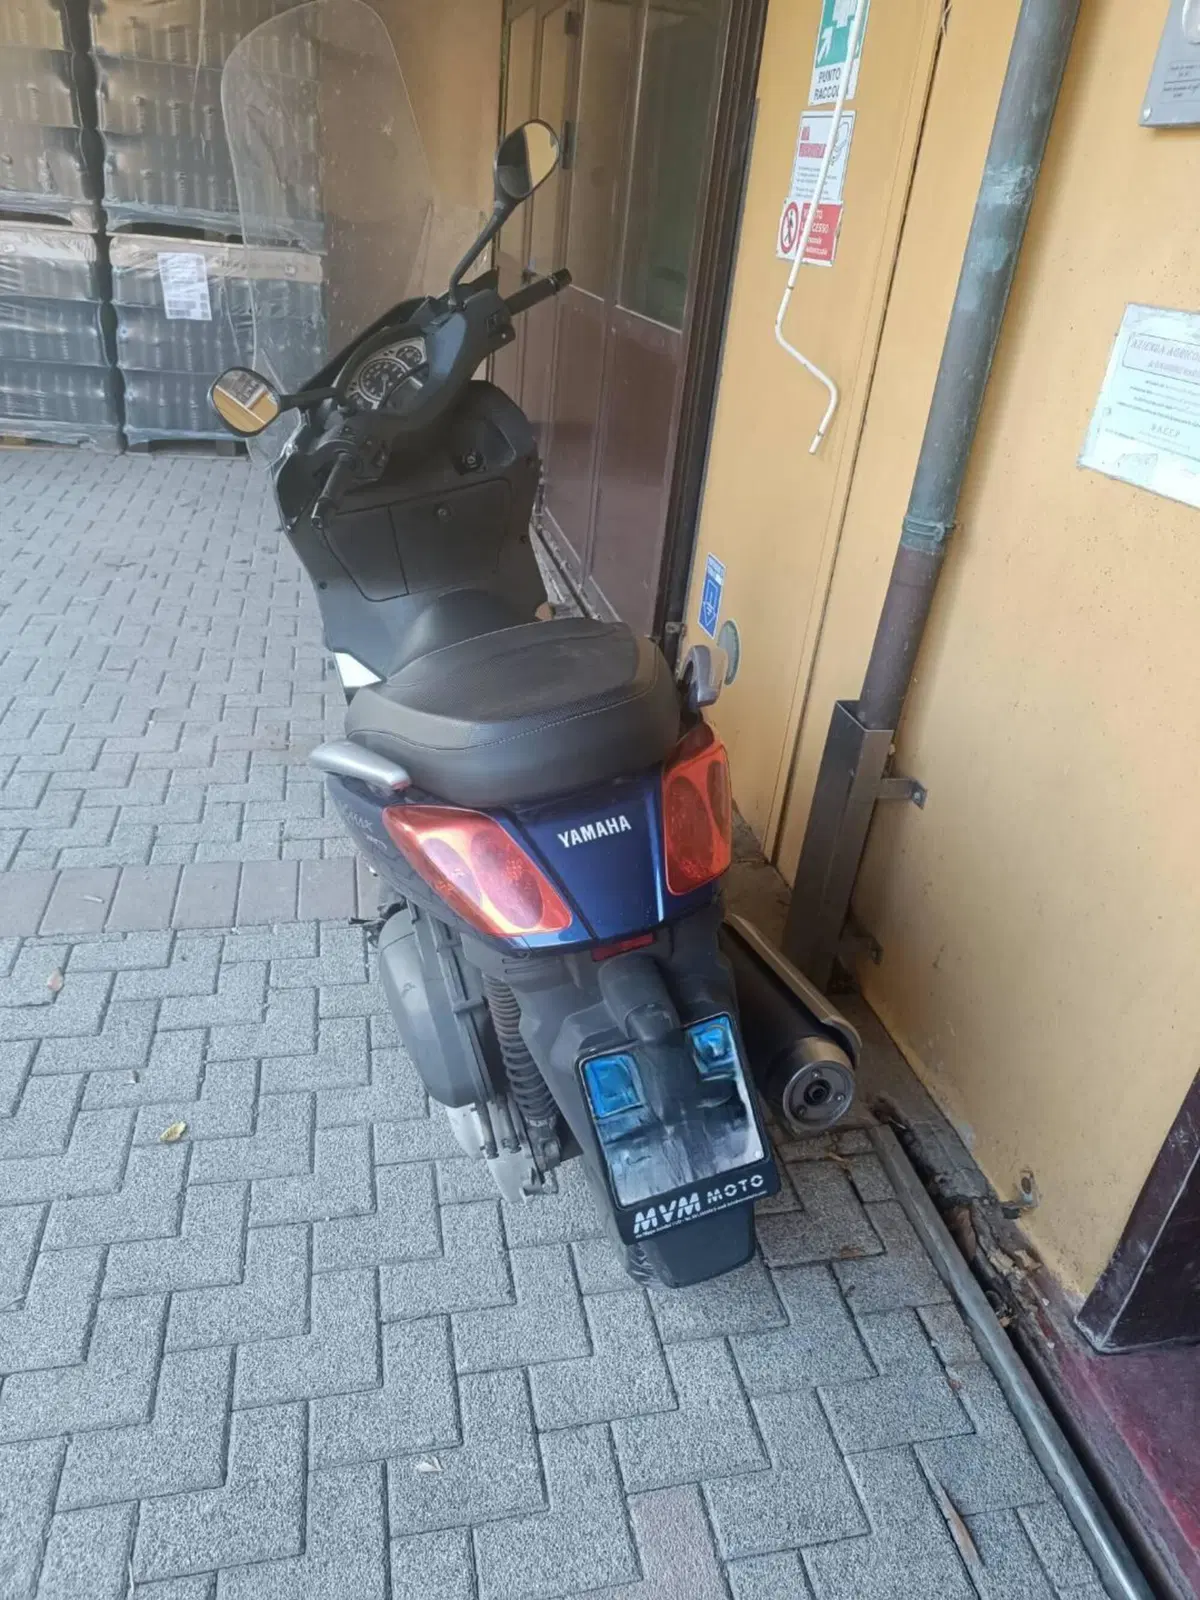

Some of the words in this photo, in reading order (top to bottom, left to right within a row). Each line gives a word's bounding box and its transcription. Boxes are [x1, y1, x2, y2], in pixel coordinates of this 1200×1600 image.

[818, 67, 840, 83] PUNTO
[557, 814, 632, 849] YAMAHA
[633, 1191, 702, 1235] MVM
[706, 1173, 764, 1205] MOTO
